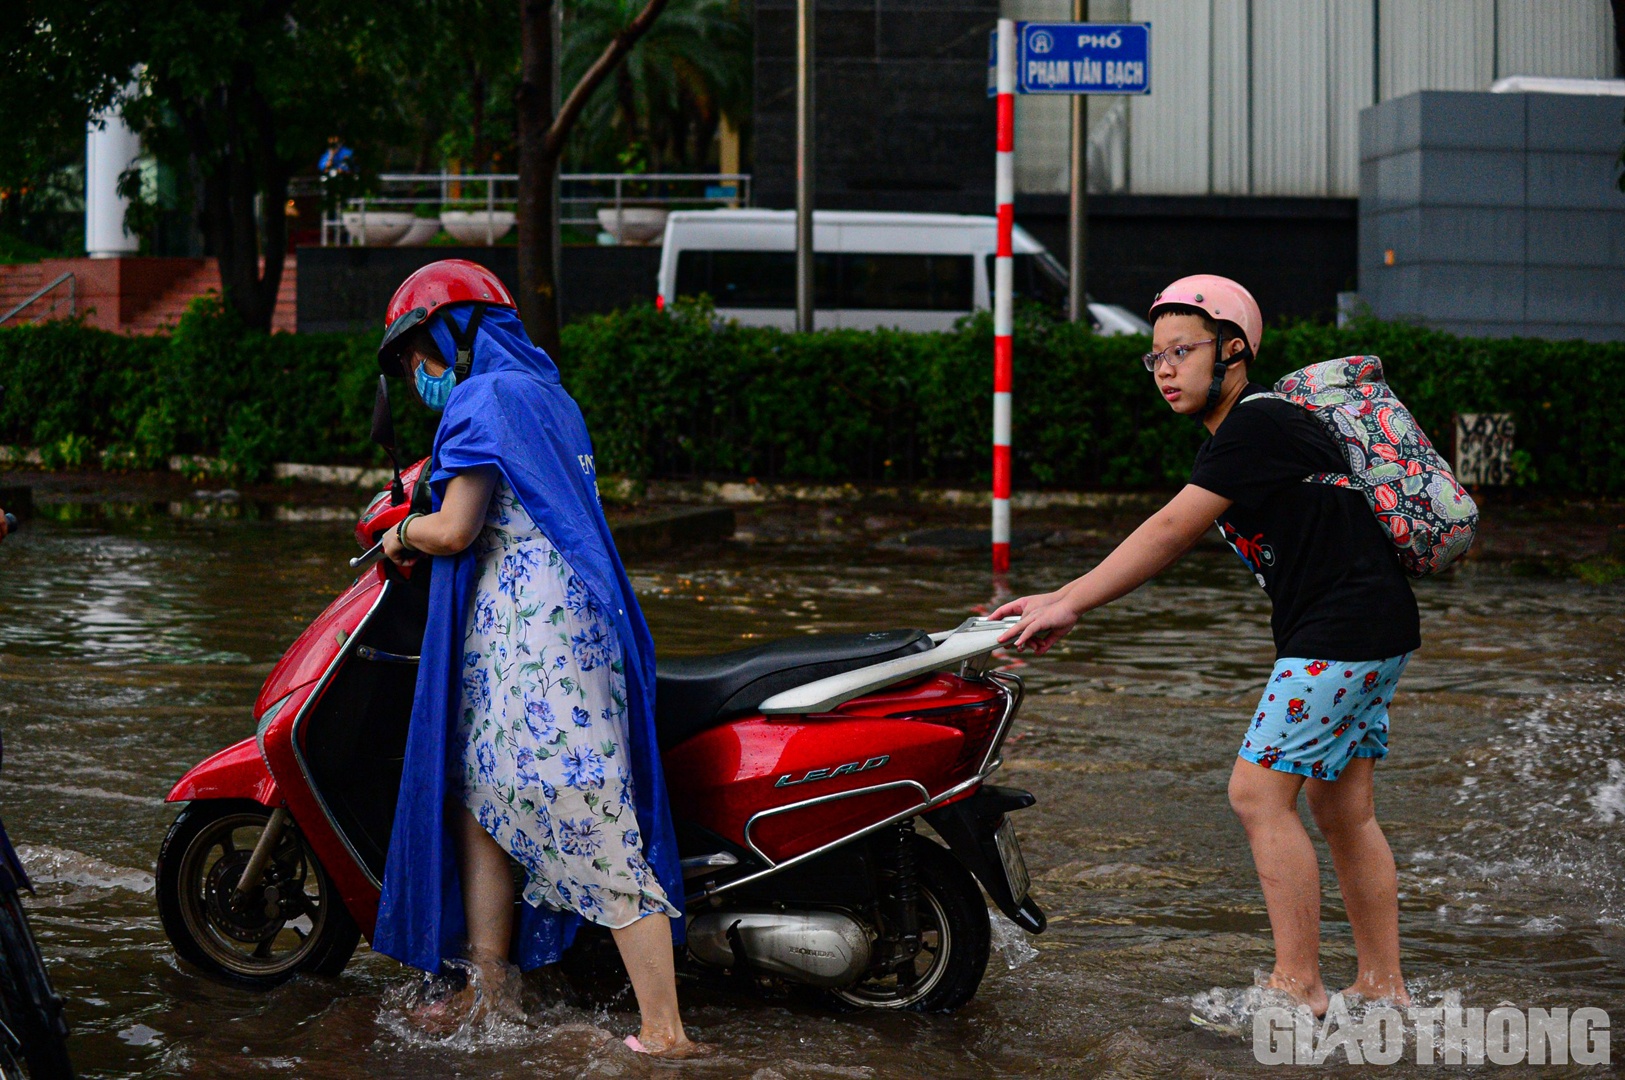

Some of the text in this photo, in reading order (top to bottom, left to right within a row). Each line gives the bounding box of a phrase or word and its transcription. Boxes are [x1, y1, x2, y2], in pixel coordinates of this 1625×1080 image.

[1077, 29, 1122, 48] PHỐ
[1028, 61, 1070, 88] PHẠM
[1073, 57, 1102, 85] VĂN
[1105, 61, 1144, 88] BẠCH
[774, 754, 890, 787] LEAD
[788, 945, 837, 959] HONDA
